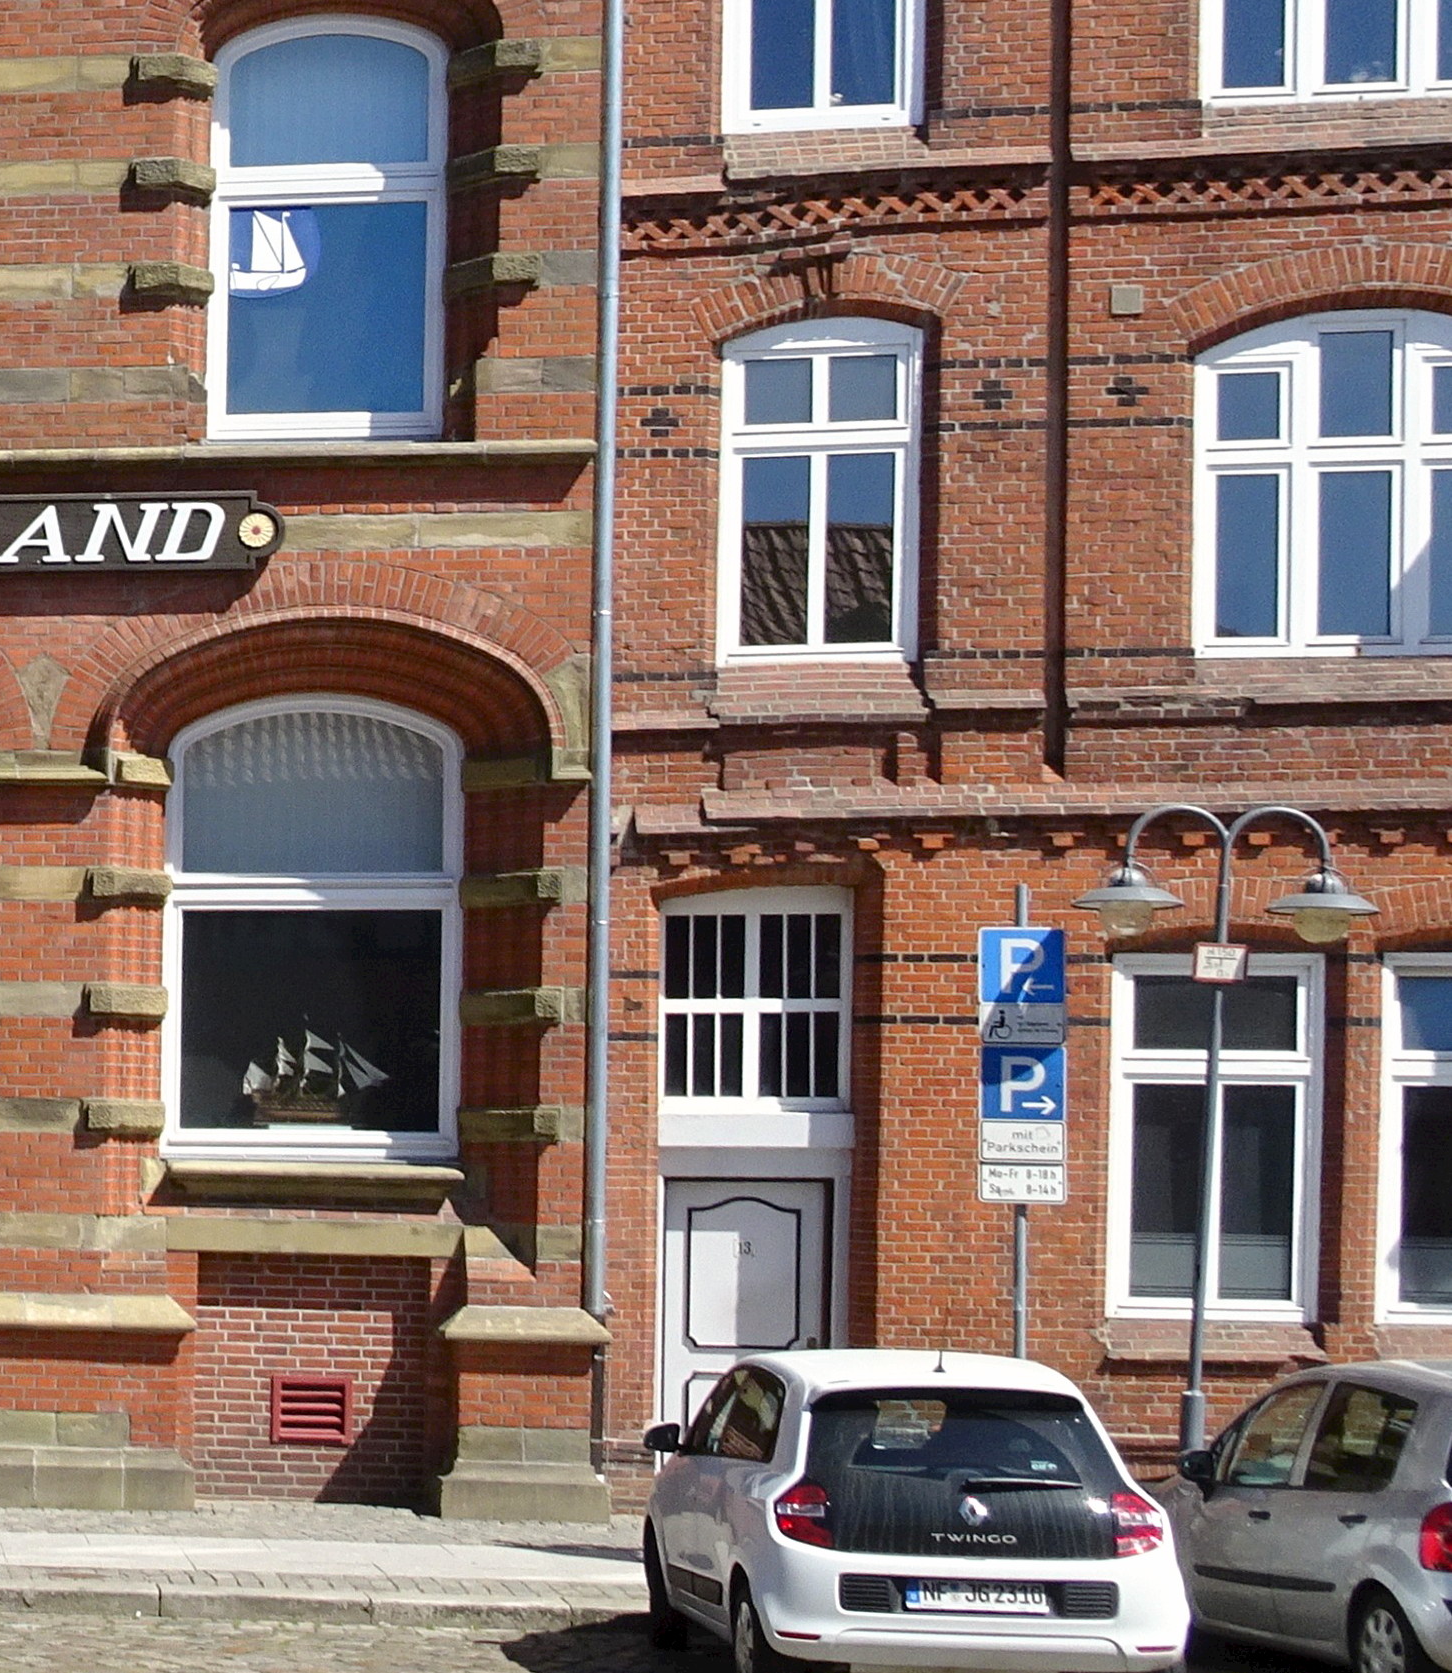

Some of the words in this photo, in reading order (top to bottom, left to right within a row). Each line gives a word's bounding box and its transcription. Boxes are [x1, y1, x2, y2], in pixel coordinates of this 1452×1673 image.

[1000, 938, 1045, 994] P
[1000, 1056, 1046, 1112] P
[1011, 1130, 1033, 1140] mit
[986, 1141, 1059, 1154] Parkschein
[988, 1168, 1019, 1179] Mo-Fr
[931, 1532, 1017, 1545] TWINGO
[922, 1581, 947, 1602] NF
